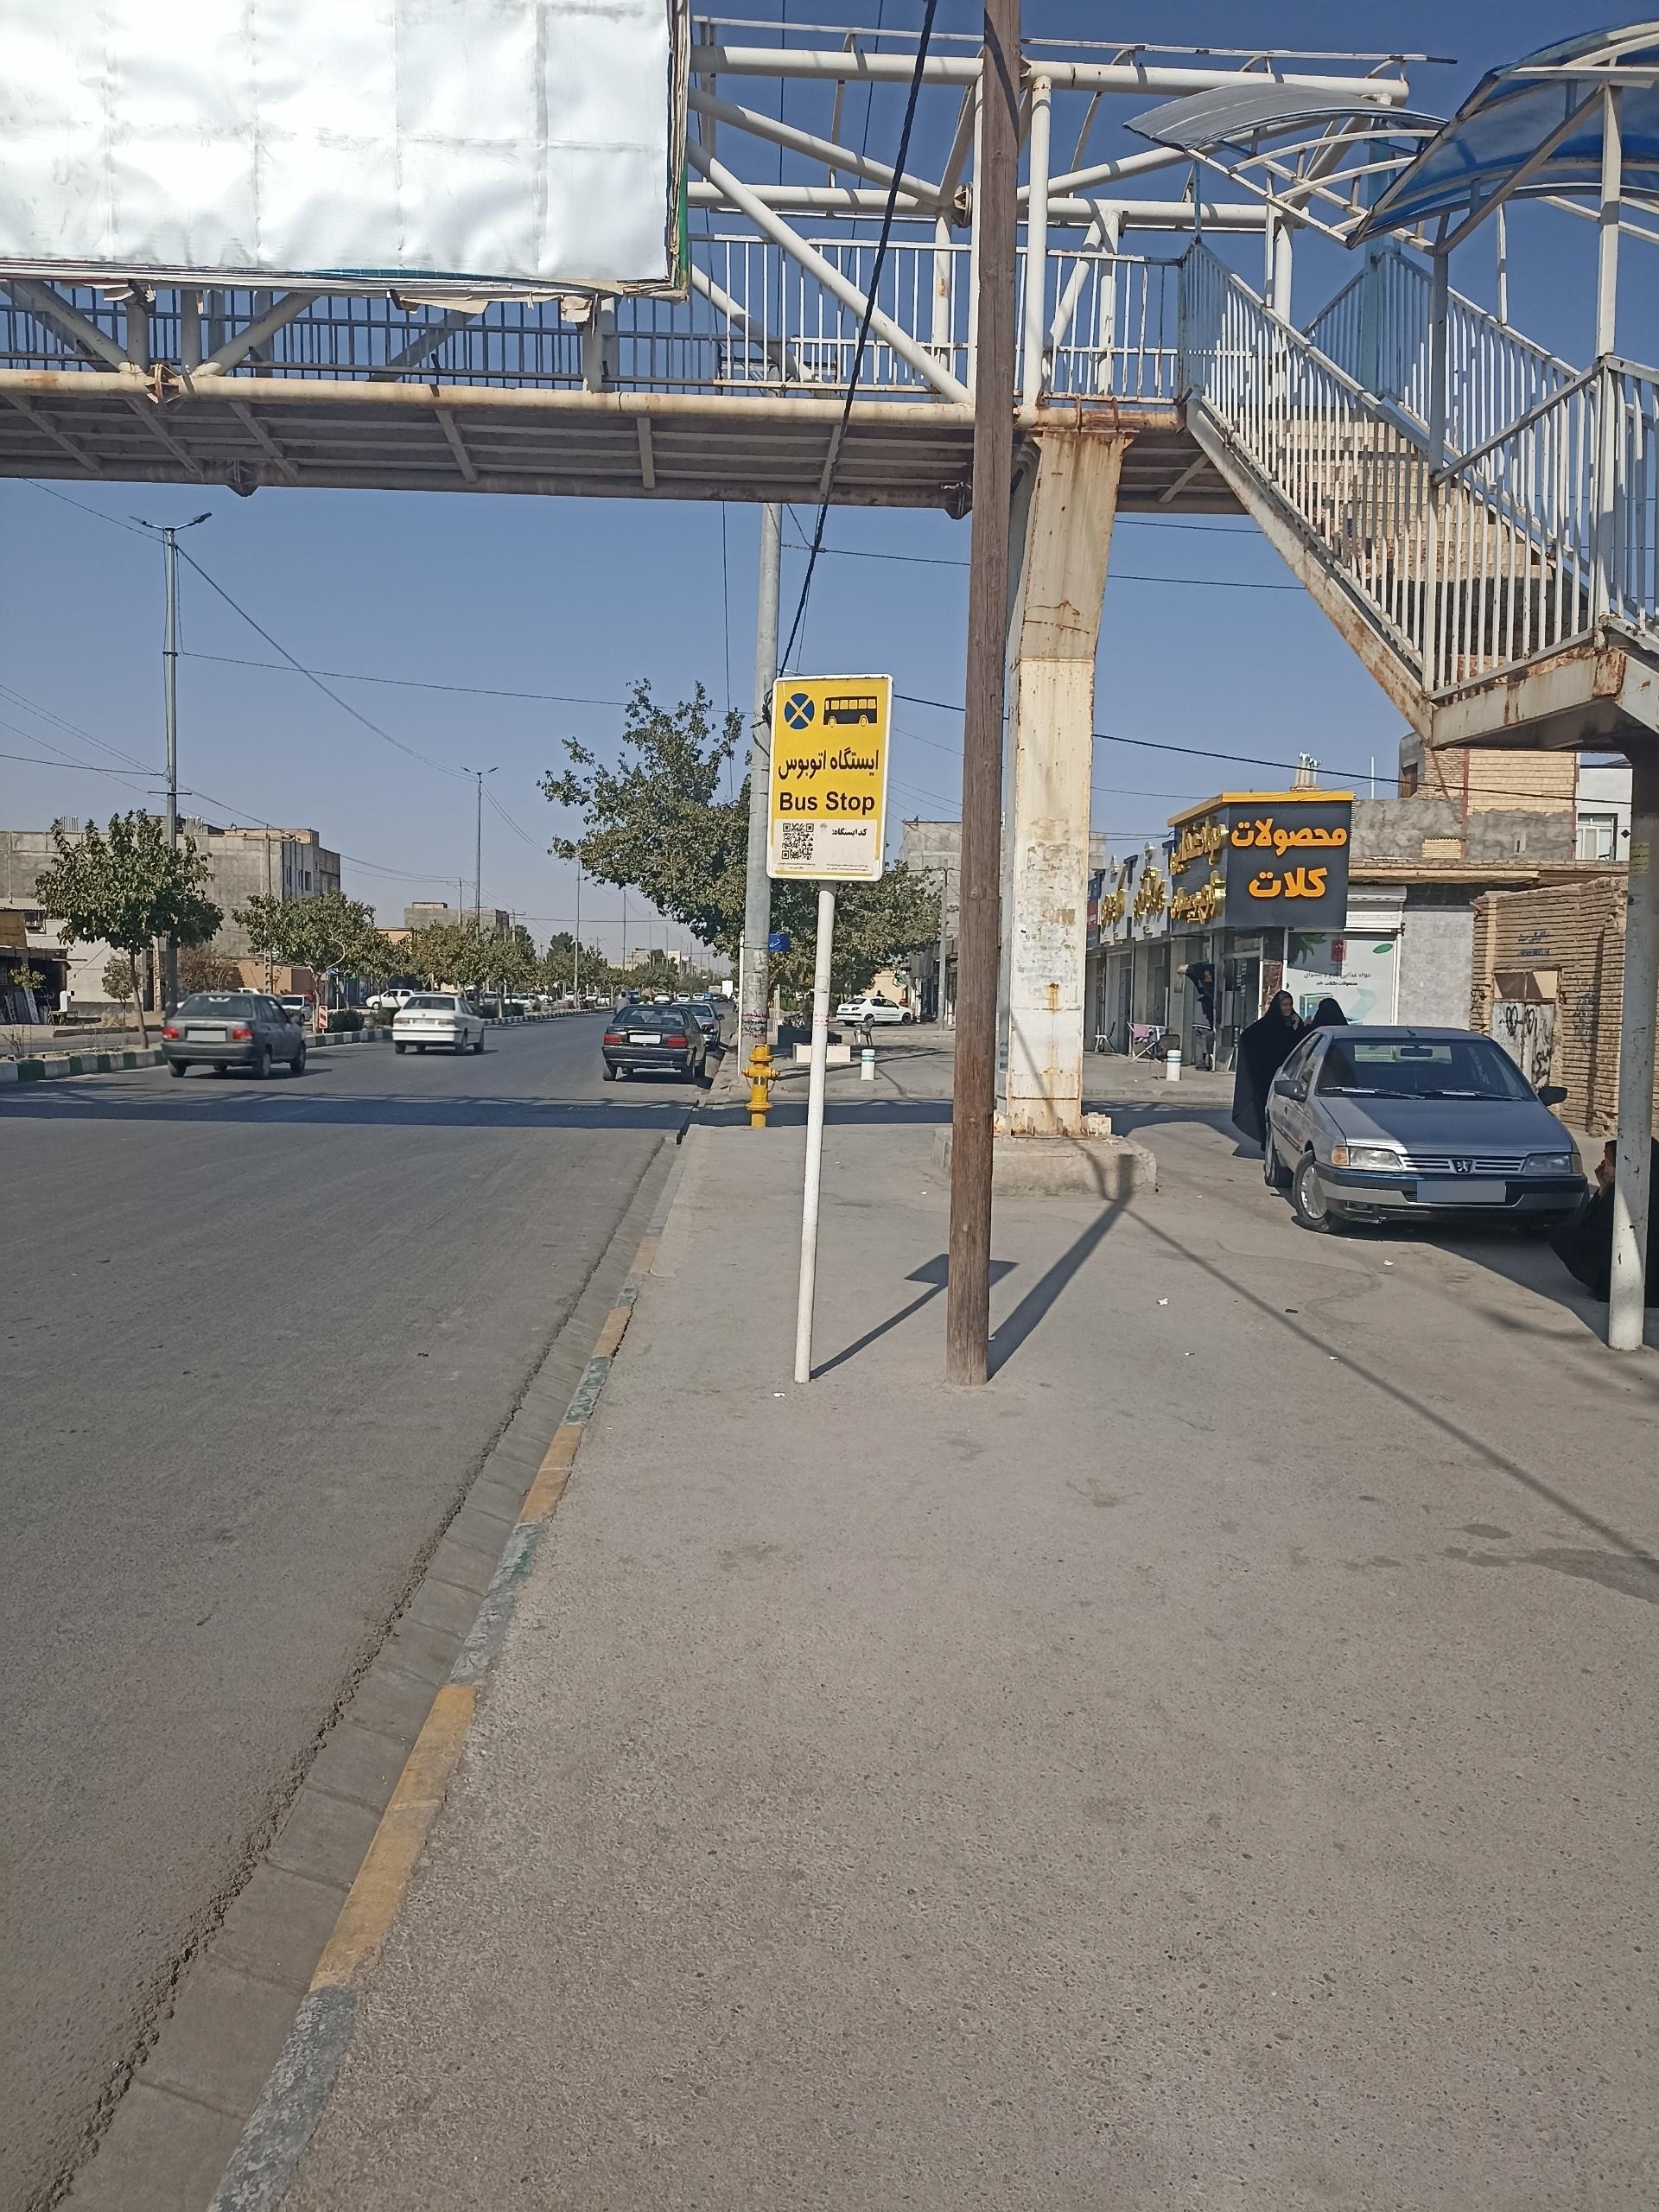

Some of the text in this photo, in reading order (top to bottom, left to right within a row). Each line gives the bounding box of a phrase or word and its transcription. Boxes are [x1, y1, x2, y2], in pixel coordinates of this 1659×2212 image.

[778, 747, 880, 780] ایستگاه اتوبوس
[779, 791, 875, 816] Bus Stop
[858, 828, 868, 836] کد
[1231, 817, 1348, 856] محصولات
[1249, 867, 1328, 898] کلات
